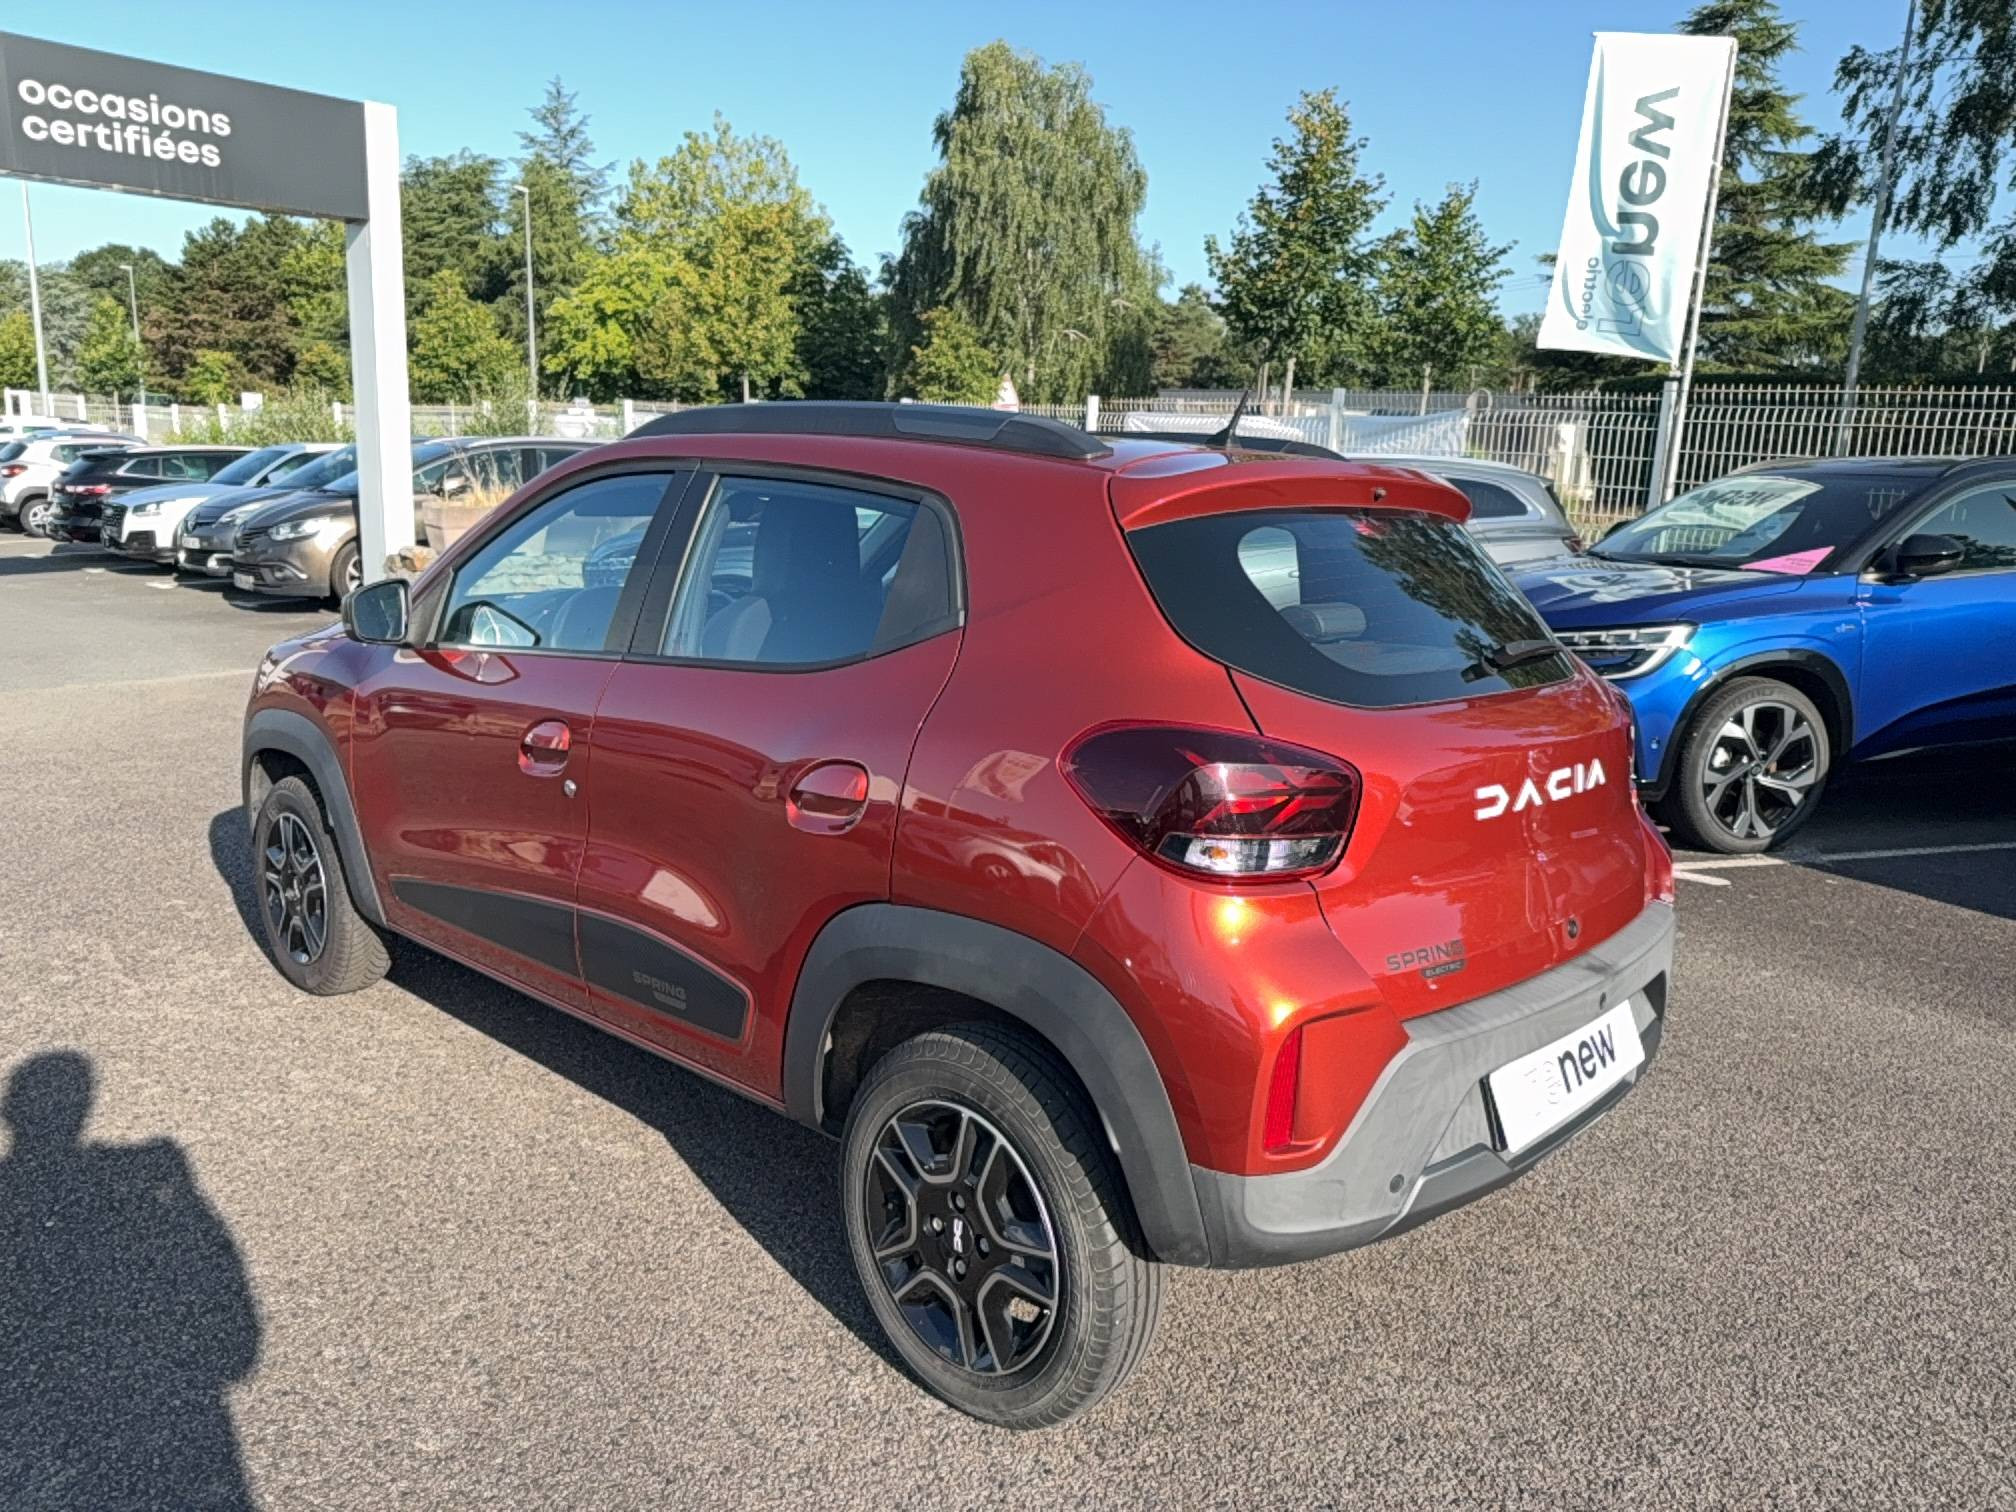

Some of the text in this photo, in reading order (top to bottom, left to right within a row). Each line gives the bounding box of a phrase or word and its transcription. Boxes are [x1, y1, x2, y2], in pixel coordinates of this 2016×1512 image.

[18, 79, 232, 137] occasions
[22, 114, 222, 168] certifiées
[1475, 758, 1606, 820] DACIA
[1386, 939, 1464, 971] SPRING
